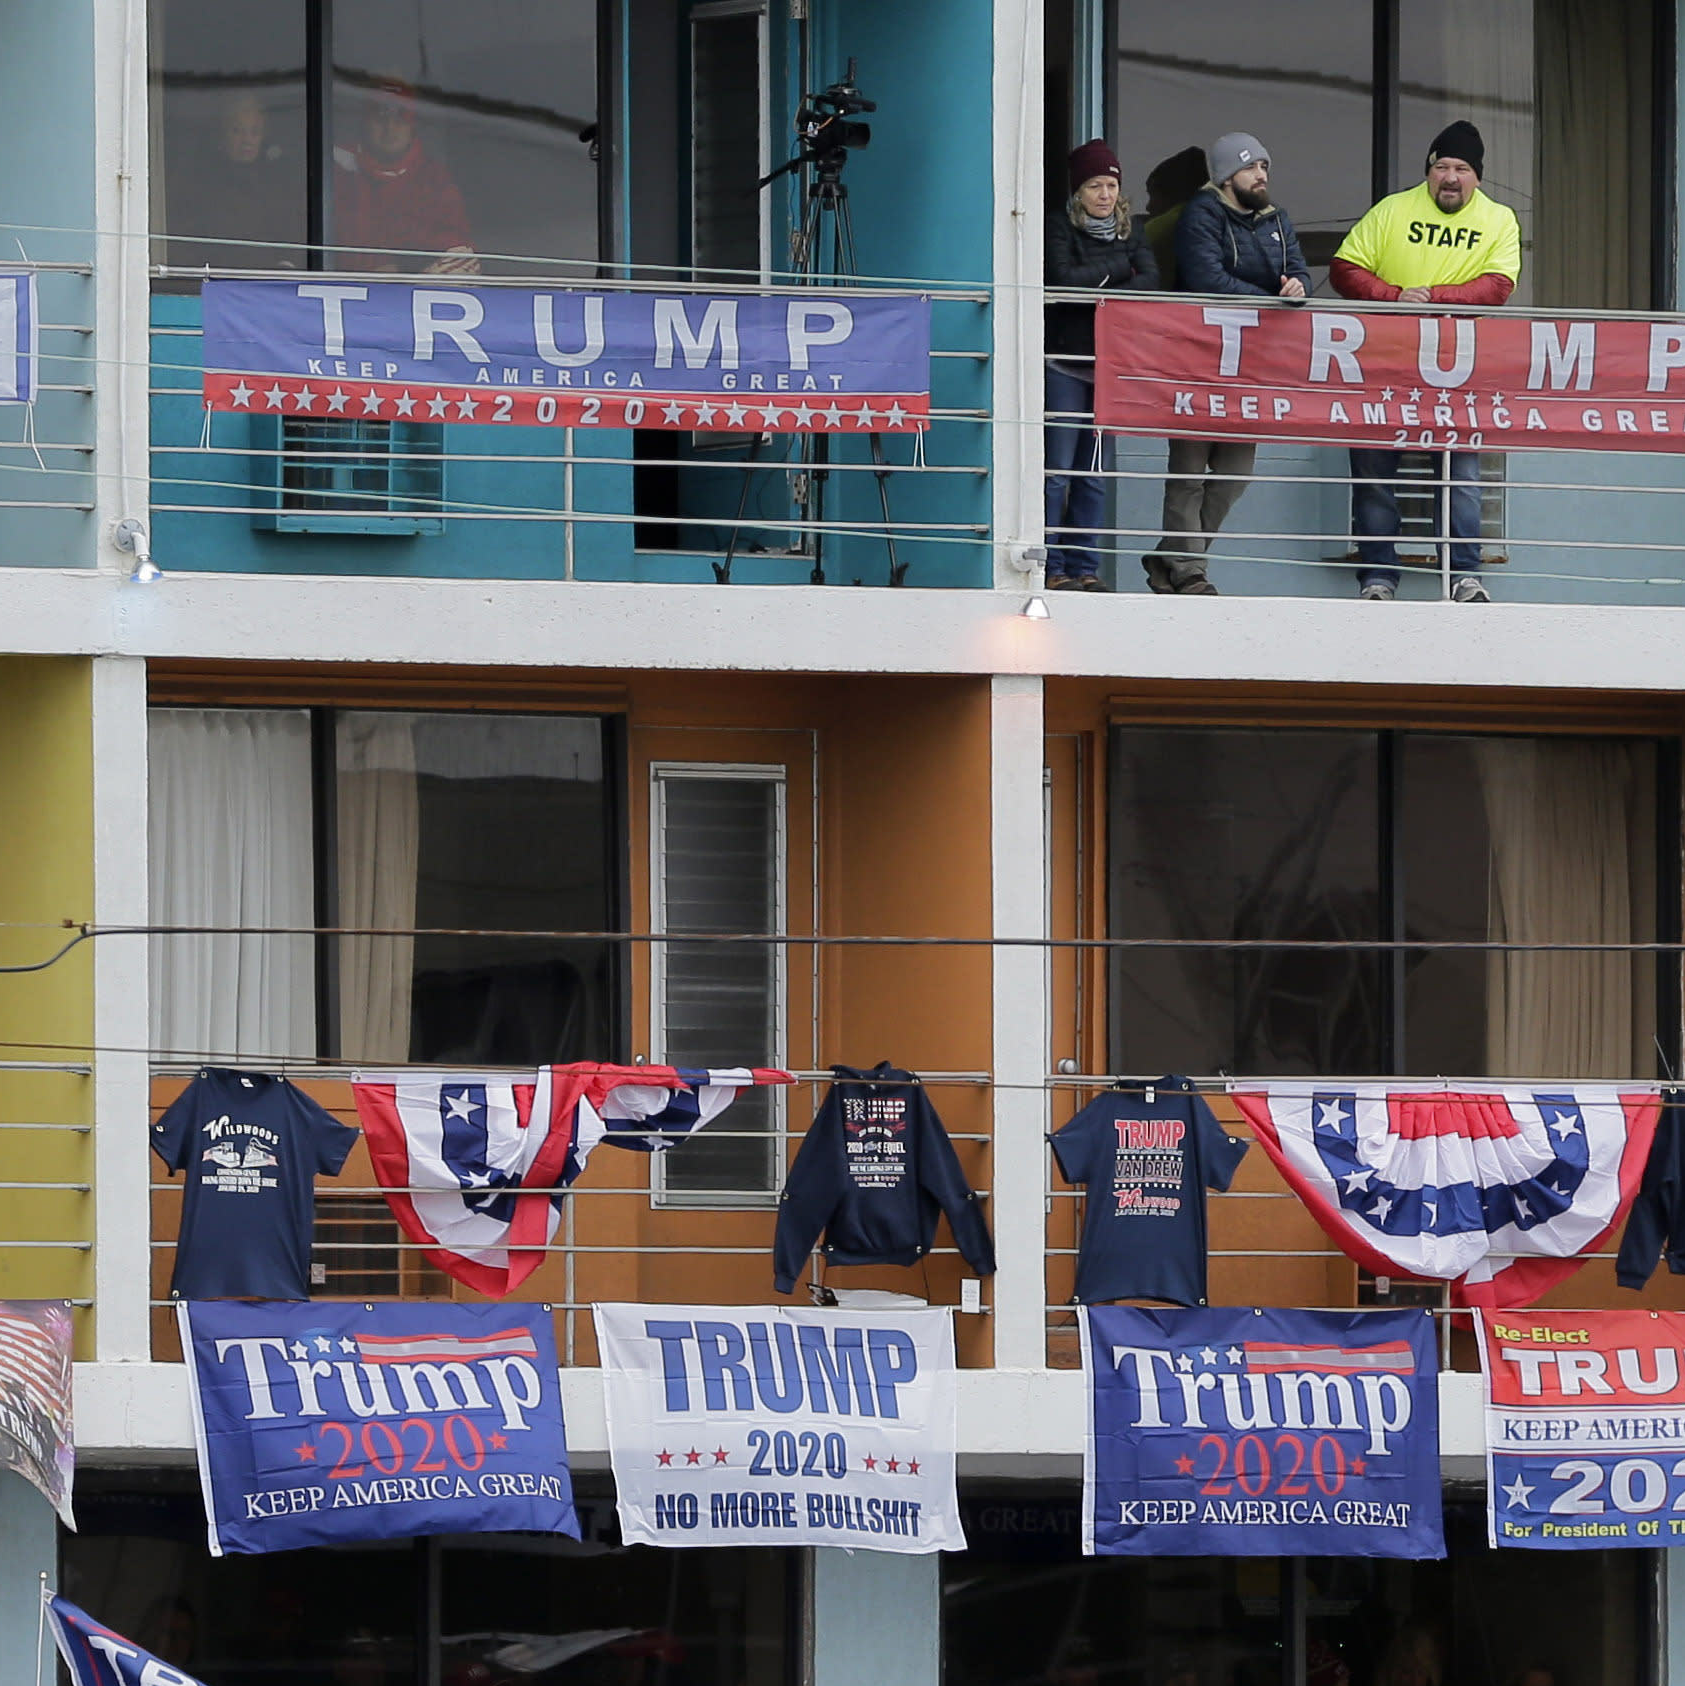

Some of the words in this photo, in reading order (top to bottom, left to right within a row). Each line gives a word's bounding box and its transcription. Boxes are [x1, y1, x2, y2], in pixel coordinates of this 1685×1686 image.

[1407, 221, 1483, 251] STAFF
[297, 284, 854, 370] TRUMP
[308, 359, 399, 379] KEEP
[476, 366, 644, 388] AMERICA
[722, 372, 845, 390] GREAT
[491, 395, 645, 426] 2020
[1173, 391, 1292, 421] KEEP
[1329, 401, 1547, 431] AMERICA
[1394, 429, 1484, 450] 2020
[202, 1114, 280, 1145] WILDWOODS
[1114, 1119, 1185, 1149] TRUMP
[1116, 1160, 1143, 1178] VAN
[1145, 1160, 1184, 1179] DREW
[1494, 1323, 1589, 1346] Re-Elect
[217, 1335, 542, 1431] Trump
[645, 1319, 918, 1420] TRUMP
[1114, 1344, 1412, 1456] Trump
[1503, 1418, 1579, 1443] KEEP
[318, 1415, 485, 1478] 2020
[747, 1429, 848, 1481] 2020
[1198, 1434, 1346, 1497] 2020
[244, 1488, 326, 1521] KEEP
[330, 1476, 474, 1510] AMERICA
[477, 1472, 561, 1502] GREAT
[654, 1491, 699, 1531] NO
[710, 1491, 798, 1530] MORE
[806, 1490, 921, 1538] BULLSHIT
[1119, 1500, 1191, 1526] KEEP
[1192, 1500, 1323, 1526] AMERICA
[1328, 1501, 1410, 1528] GREAT
[1504, 1520, 1533, 1539] For
[1543, 1519, 1627, 1540] President
[1636, 1519, 1660, 1538] Of
